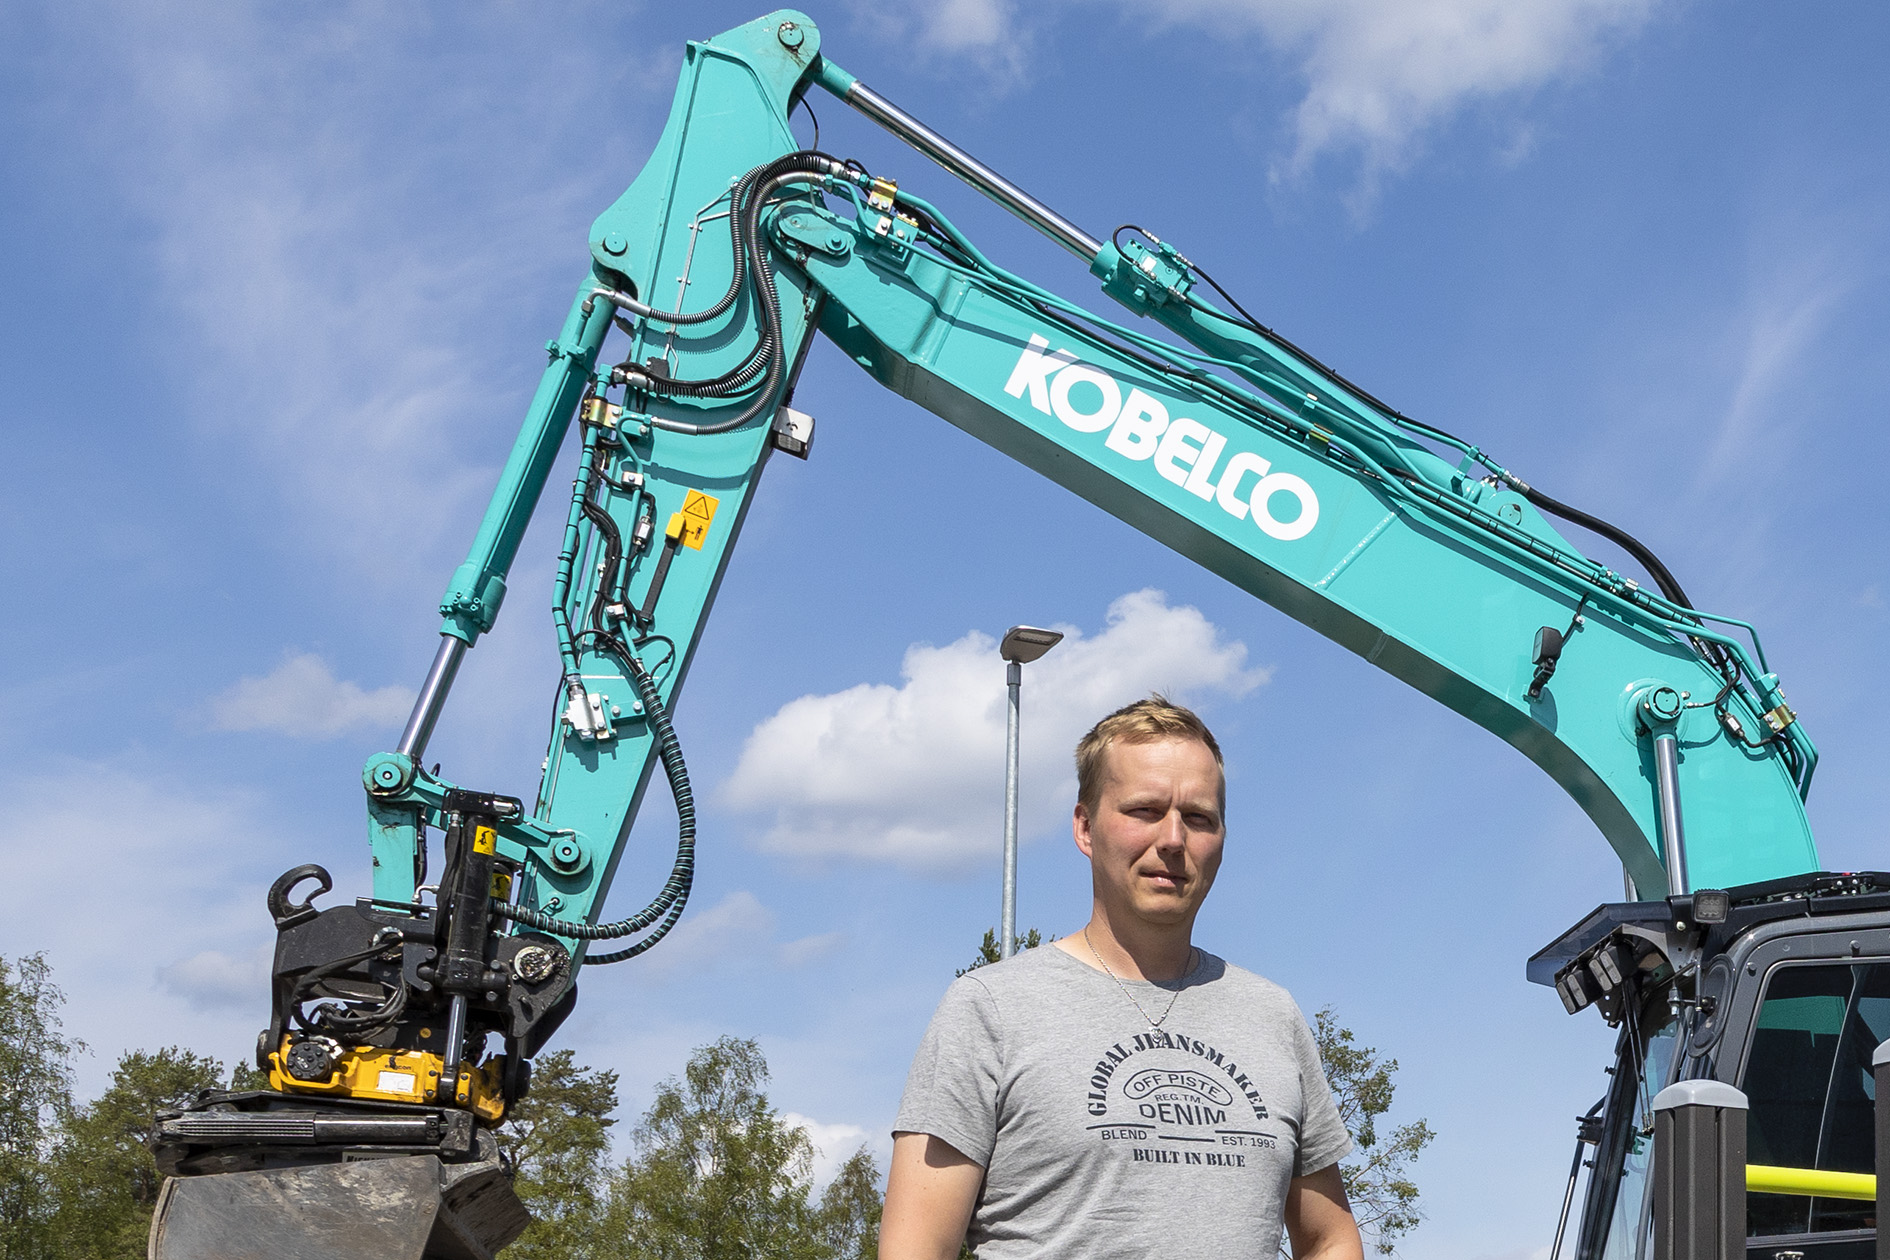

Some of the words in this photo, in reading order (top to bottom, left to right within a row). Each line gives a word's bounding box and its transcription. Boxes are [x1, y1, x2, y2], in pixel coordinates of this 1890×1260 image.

[1003, 332, 1320, 541] KOBELCO
[1087, 1043, 1132, 1116] GLOBAL
[1133, 1074, 1162, 1092] OFF
[1168, 1074, 1221, 1098] PISTE
[1139, 1103, 1227, 1126] DENIM
[1101, 1130, 1148, 1141] BLEND
[1222, 1136, 1248, 1147] EST.
[1250, 1137, 1276, 1150] 1993
[1133, 1149, 1180, 1164] BUILT
[1185, 1152, 1201, 1165] IN
[1206, 1153, 1246, 1168] BLUE
